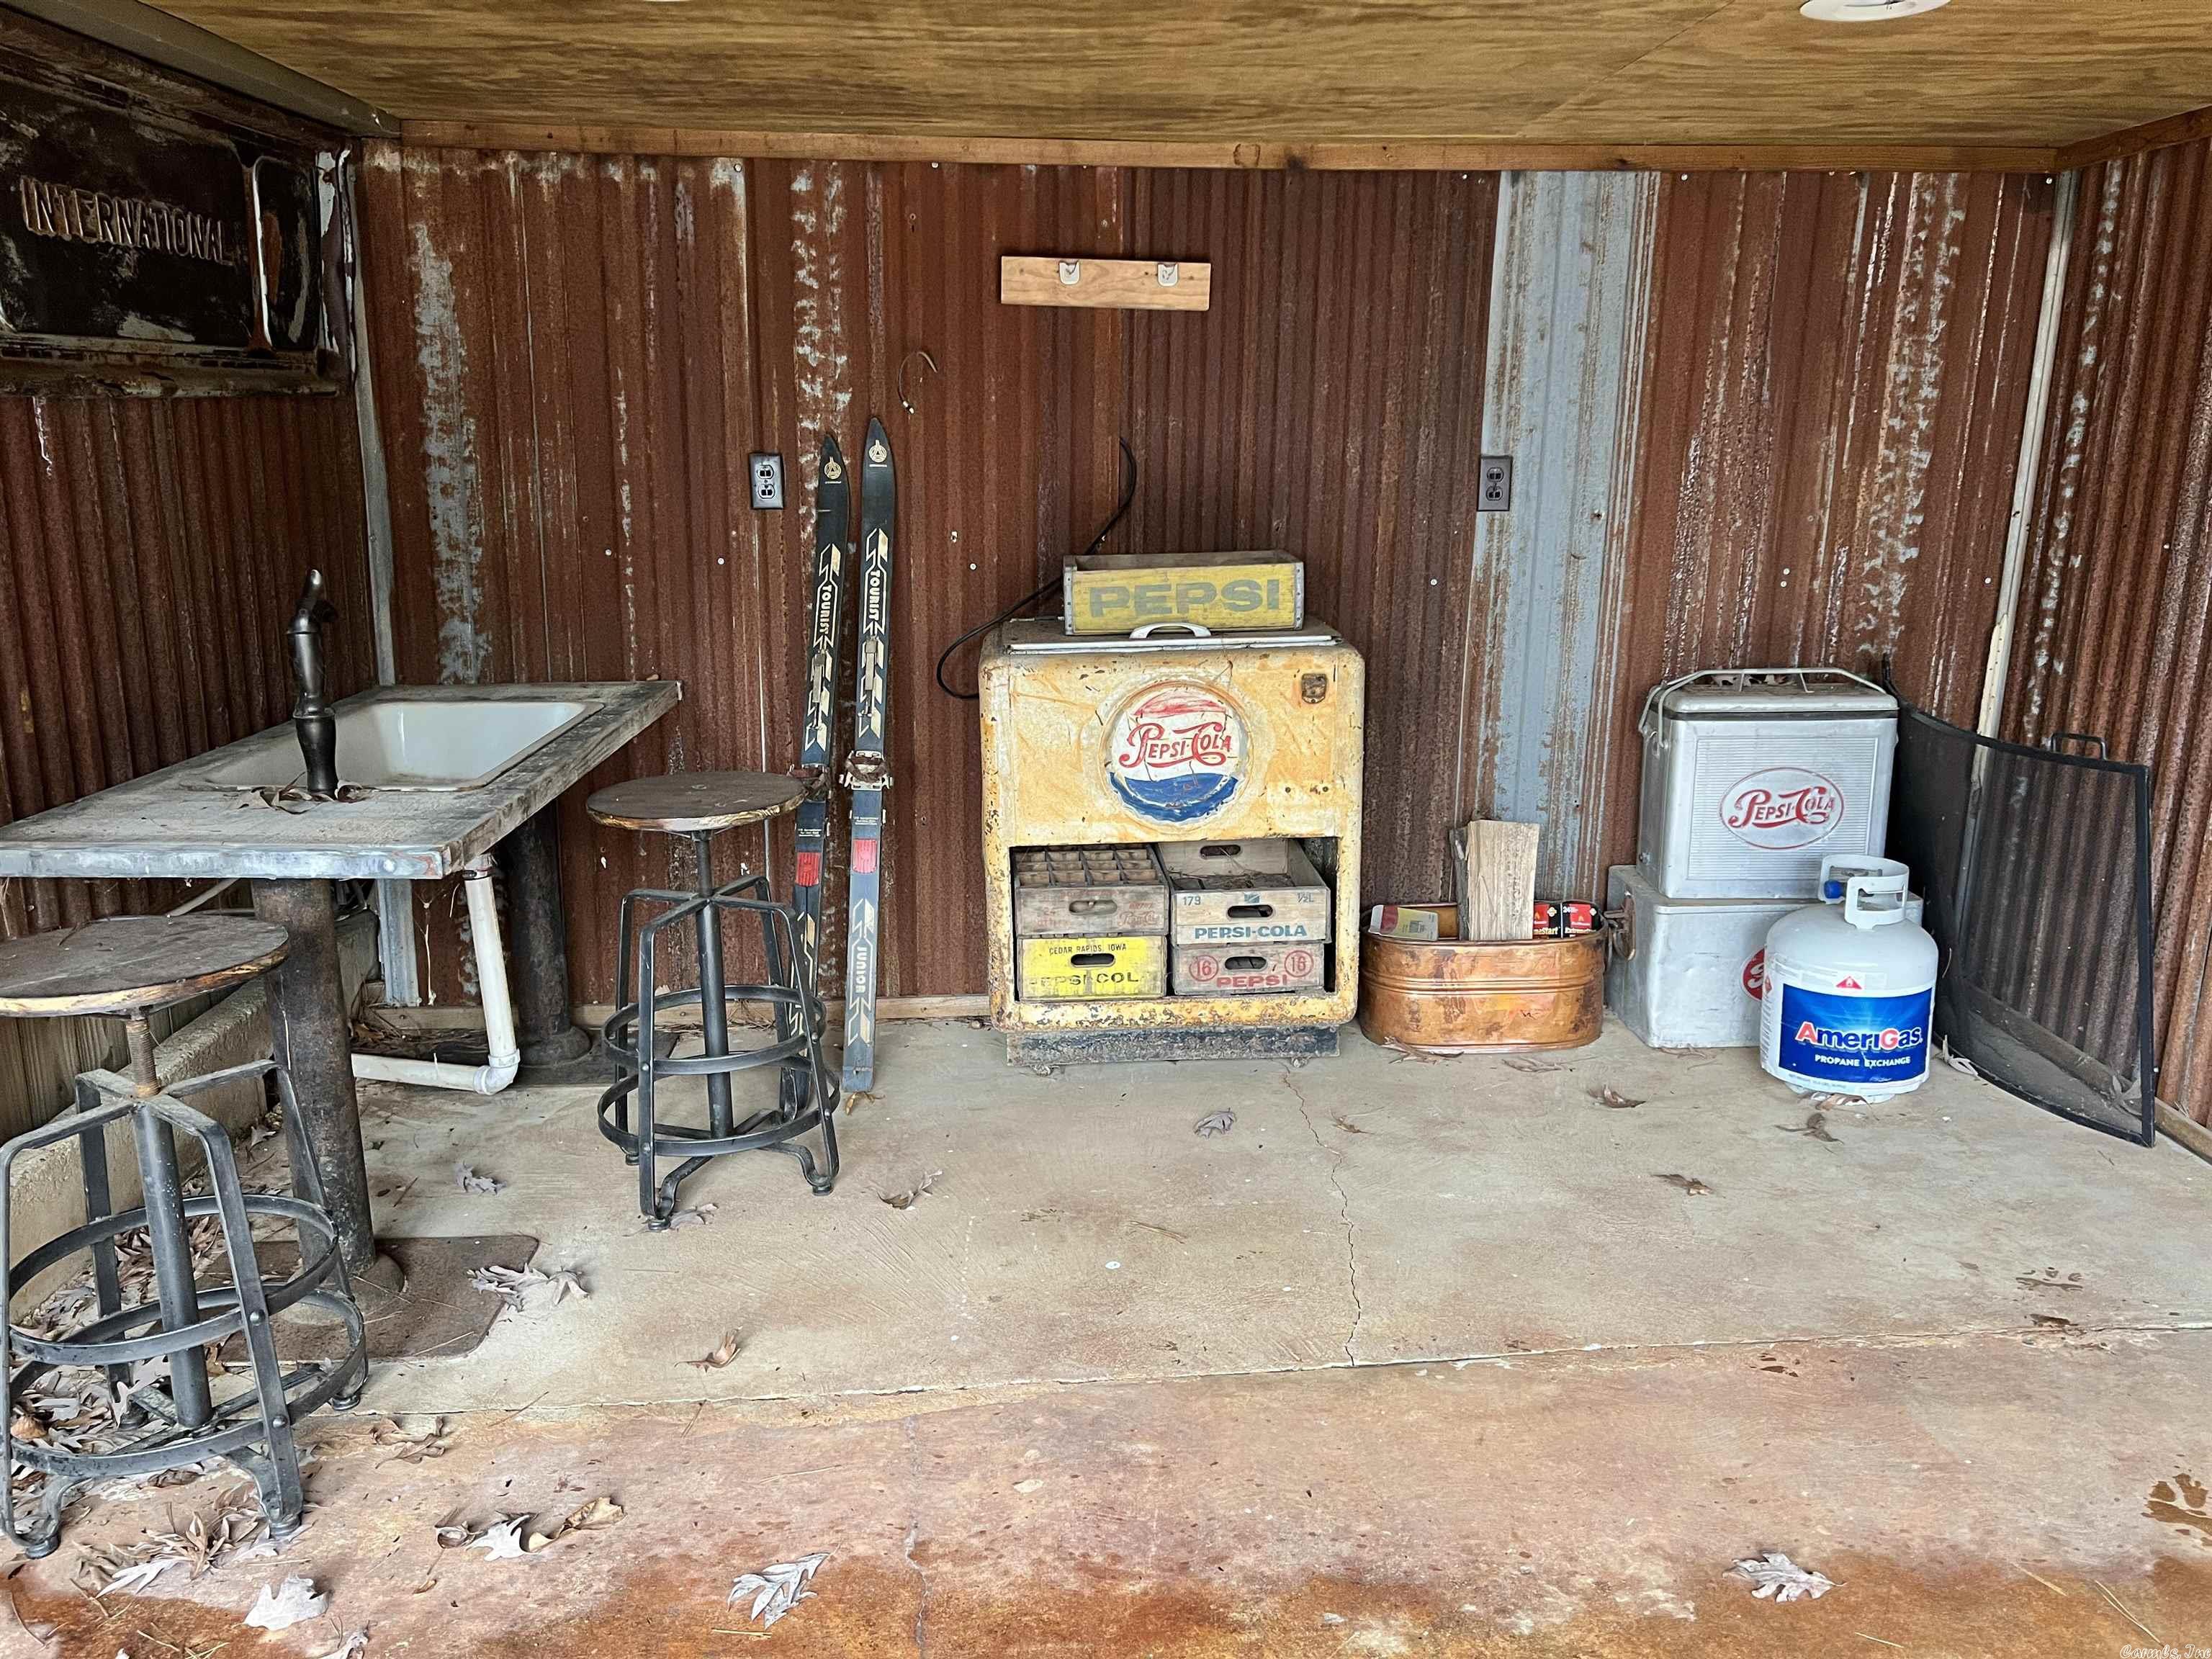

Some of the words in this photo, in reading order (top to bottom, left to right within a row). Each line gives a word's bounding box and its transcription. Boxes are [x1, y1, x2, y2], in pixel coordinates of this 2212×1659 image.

[20, 176, 235, 266] INTERNATIONAL
[869, 570, 881, 621] TOURIST
[1089, 579, 1280, 618] PEPSI
[819, 585, 832, 634] TOURIST
[1194, 925, 1308, 939] PEPSI-COLA
[1049, 946, 1072, 956] CEDAR
[855, 946, 868, 994] JUNIOR
[1196, 960, 1212, 977] 16
[1291, 955, 1307, 973] 16
[1216, 974, 1287, 988] PEPSI
[1795, 1021, 1921, 1051] AmeriGas
[1815, 1054, 1859, 1067] PROPANE
[1864, 1056, 1911, 1068] EXCHANGE
